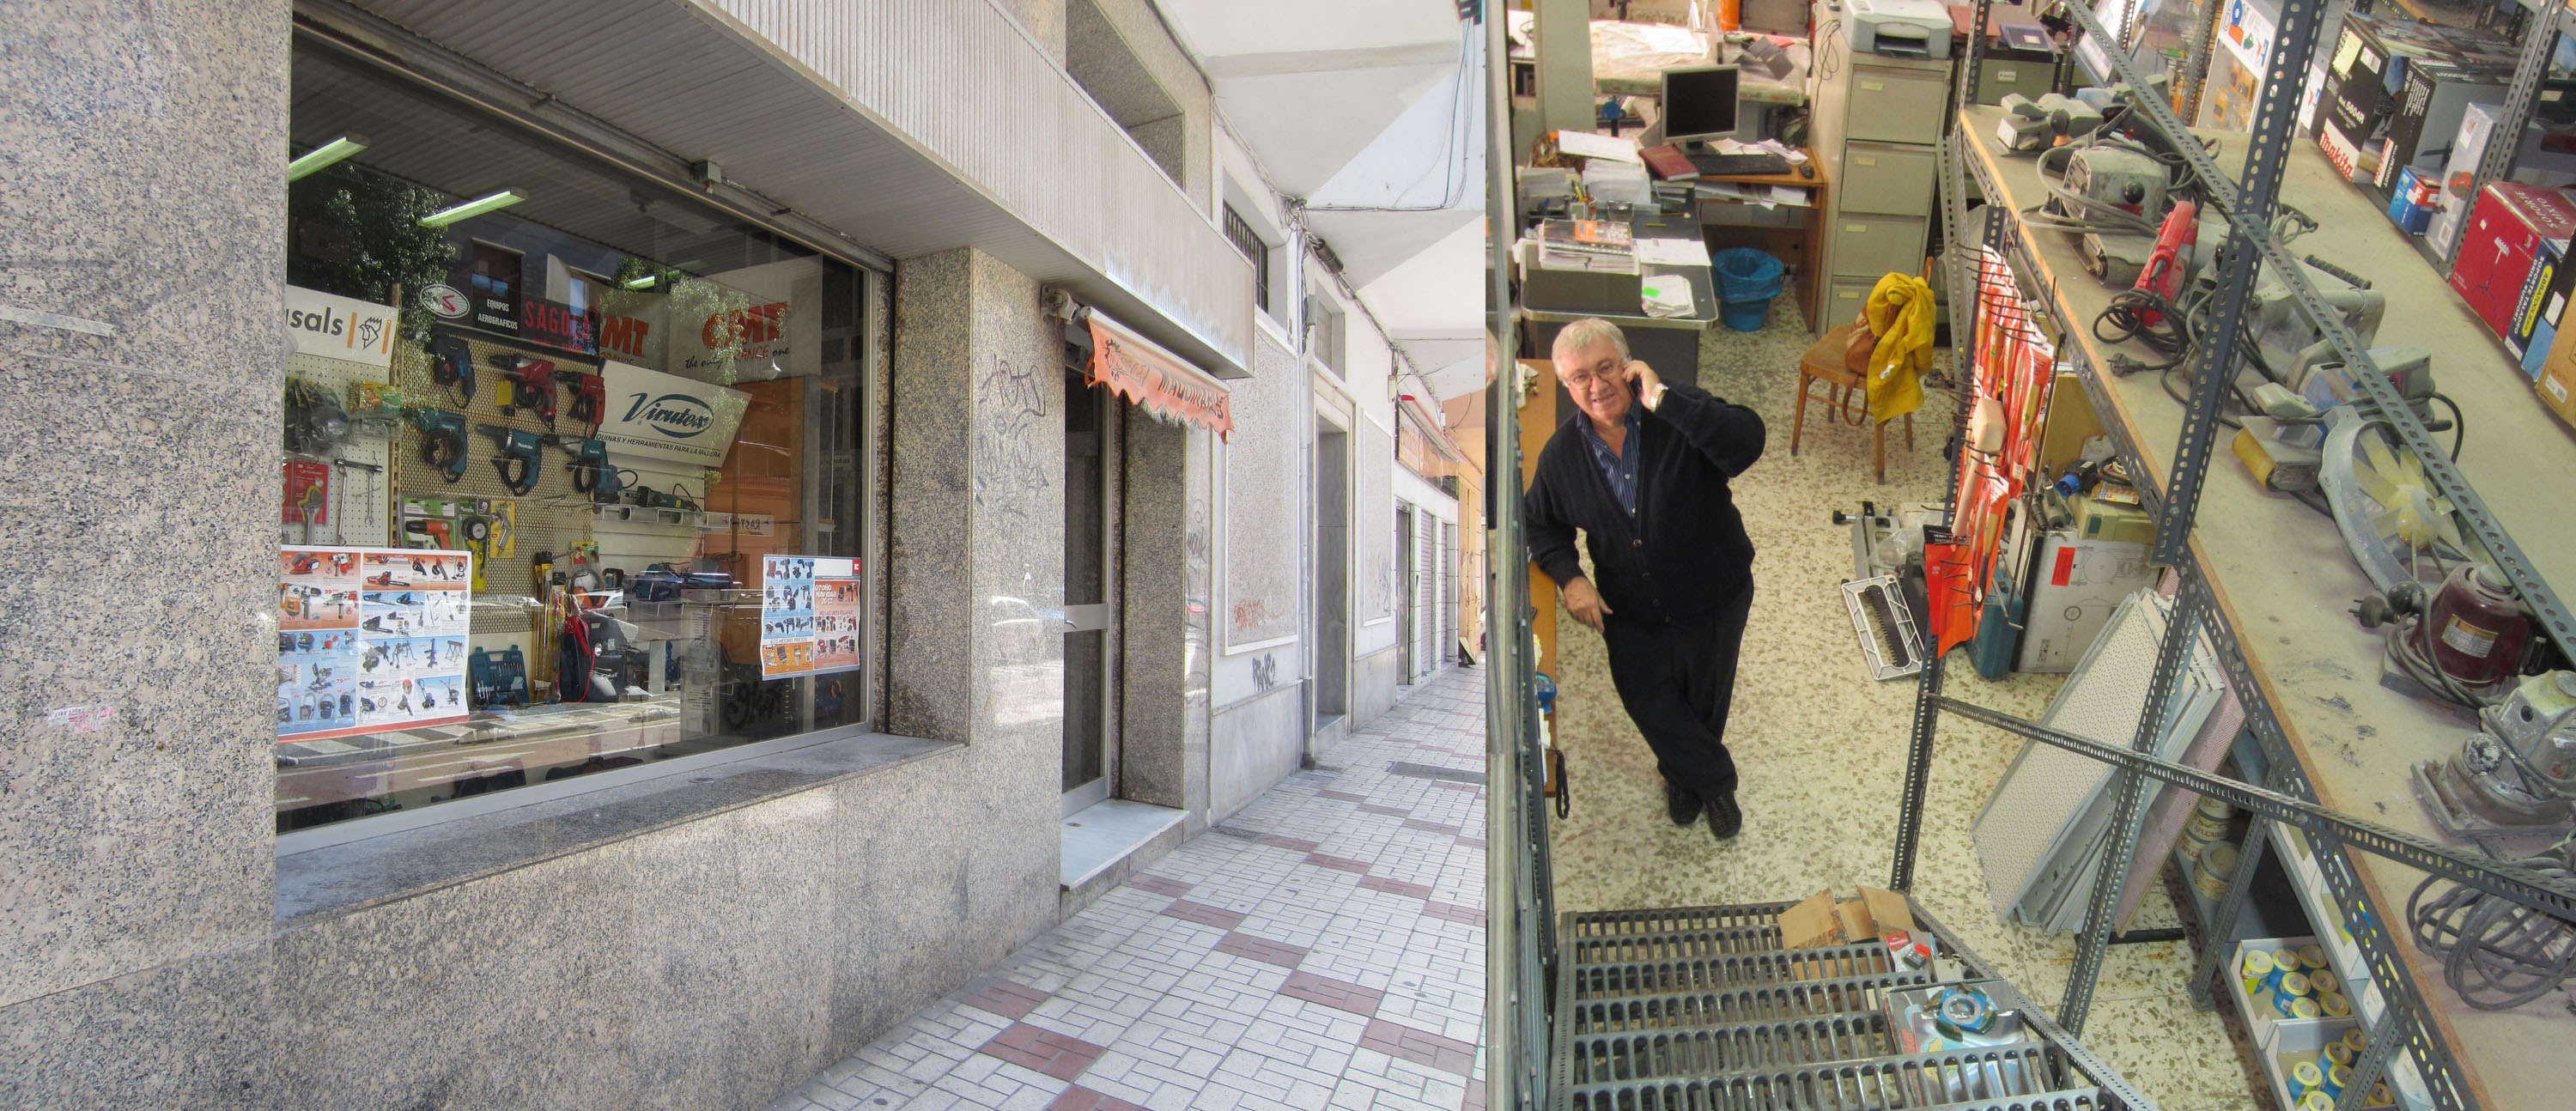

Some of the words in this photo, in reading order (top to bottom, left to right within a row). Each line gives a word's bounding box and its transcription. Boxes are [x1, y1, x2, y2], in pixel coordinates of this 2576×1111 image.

[2514, 191, 2558, 228] SOPORTE
[2537, 197, 2569, 224] MIXTO
[2526, 259, 2538, 283] DRILL
[2530, 256, 2545, 294] SOPORTE
[487, 299, 509, 312] EQUIPOS
[2512, 284, 2528, 322] SUPPORT
[2514, 294, 2530, 334] TALADRO
[286, 307, 343, 336] sals
[477, 313, 518, 330] AEROGRAFICOS
[525, 301, 591, 343] SAGOLA
[702, 301, 787, 349] CMT
[685, 355, 699, 370] the
[726, 344, 769, 363] RANGE
[772, 347, 789, 357] one
[622, 392, 709, 429] Virutex
[627, 439, 673, 451] HERRAMIENTAS
[673, 445, 689, 453] PARA
[815, 583, 832, 592] OTOÑO
